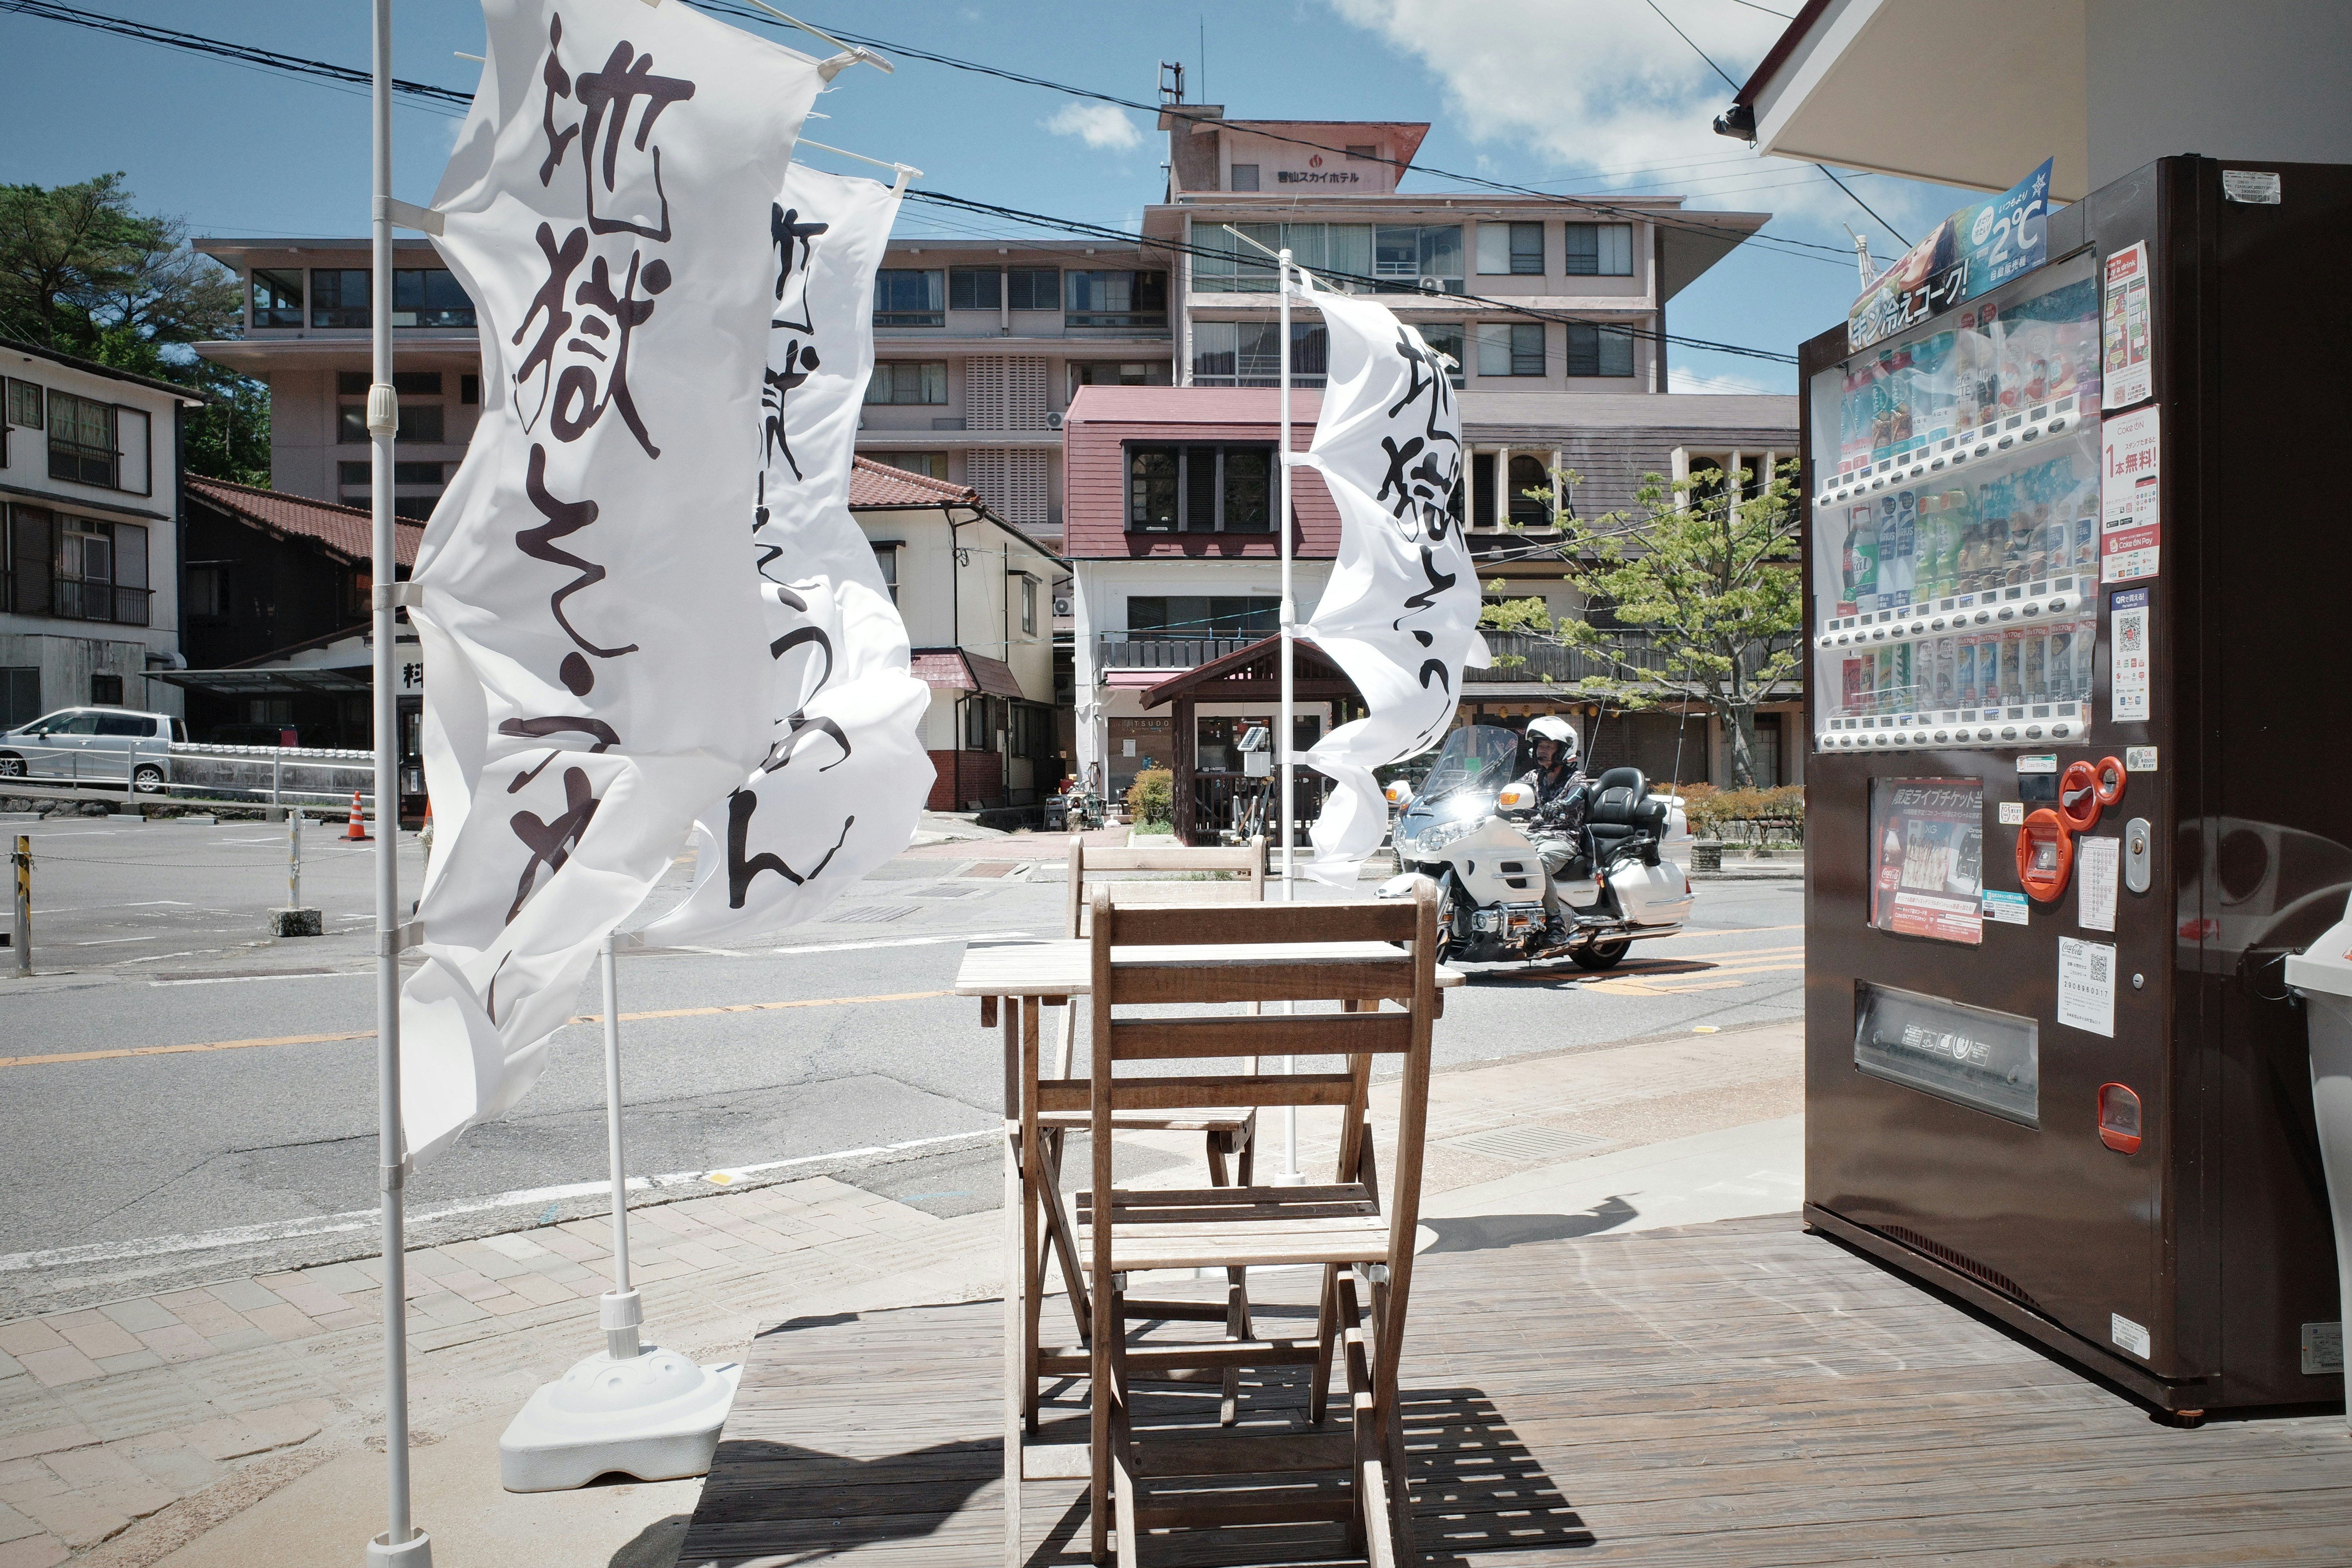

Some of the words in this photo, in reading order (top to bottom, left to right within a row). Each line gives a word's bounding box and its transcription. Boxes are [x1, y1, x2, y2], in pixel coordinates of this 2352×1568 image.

[1278, 171, 1359, 183] 雲仙スカイホテル
[1999, 190, 2028, 214] いつもより
[1990, 254, 2026, 281] 自動販売機
[2121, 259, 2136, 270] drink
[1851, 258, 1969, 346] キン冷えコーク!
[2117, 425, 2133, 435] Coke
[2125, 436, 2156, 450] スタンプたまると
[2106, 444, 2156, 478] 1本無料!
[2119, 541, 2132, 549] Coke
[2142, 537, 2153, 546] Pay
[2116, 593, 2145, 604] QRで買える!
[1925, 825, 1937, 834] XG
[2062, 941, 2083, 955] Coca-Cola
